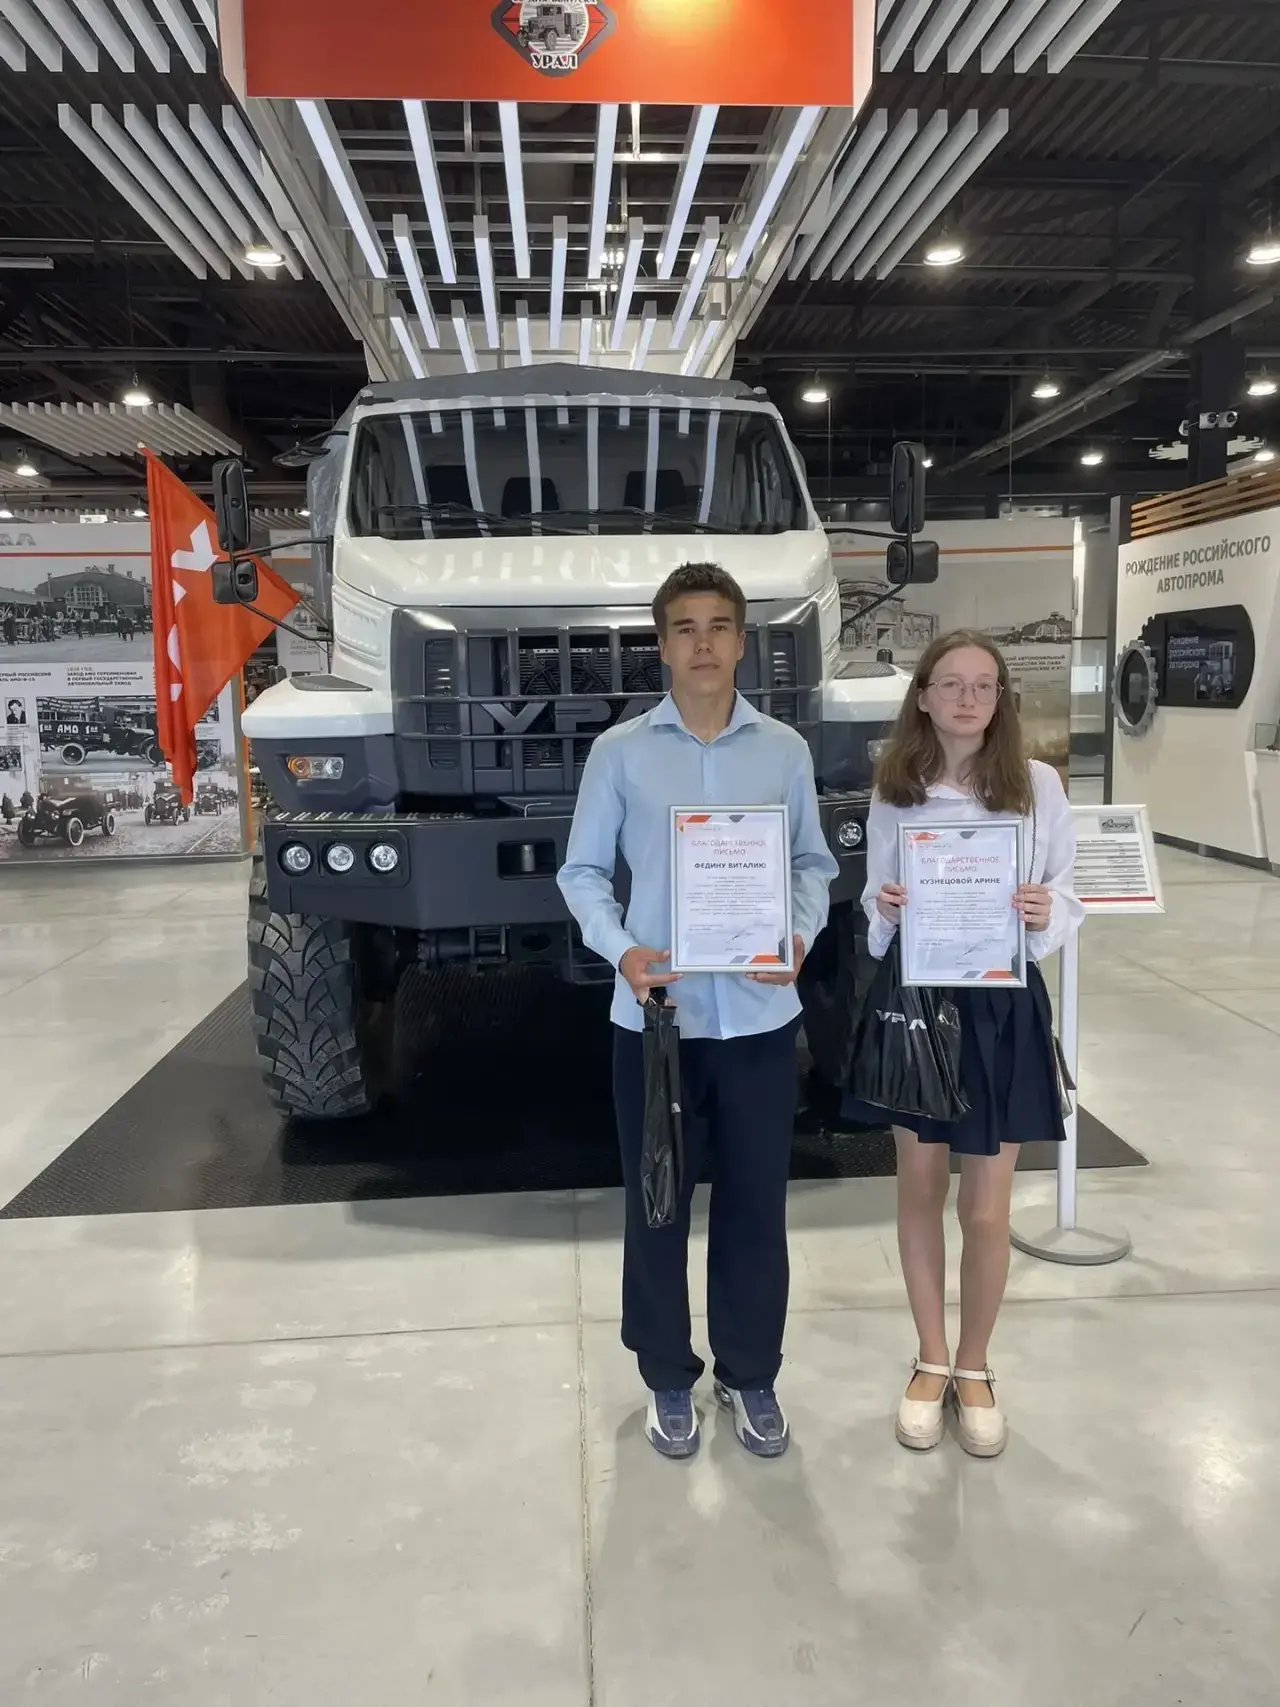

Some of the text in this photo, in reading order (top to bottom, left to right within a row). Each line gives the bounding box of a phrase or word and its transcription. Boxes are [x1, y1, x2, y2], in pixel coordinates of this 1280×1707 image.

[532, 54, 577, 68] УРАЛ
[1125, 535, 1272, 577] РОЖДЕНИЕ РОССИЙСКОГО
[1156, 569, 1225, 594] АВТОПРОМА
[57, 723, 79, 734] АМО
[694, 862, 726, 870] ФЕДИНУ
[920, 877, 973, 886] КУЗНЕЦОВОЙ
